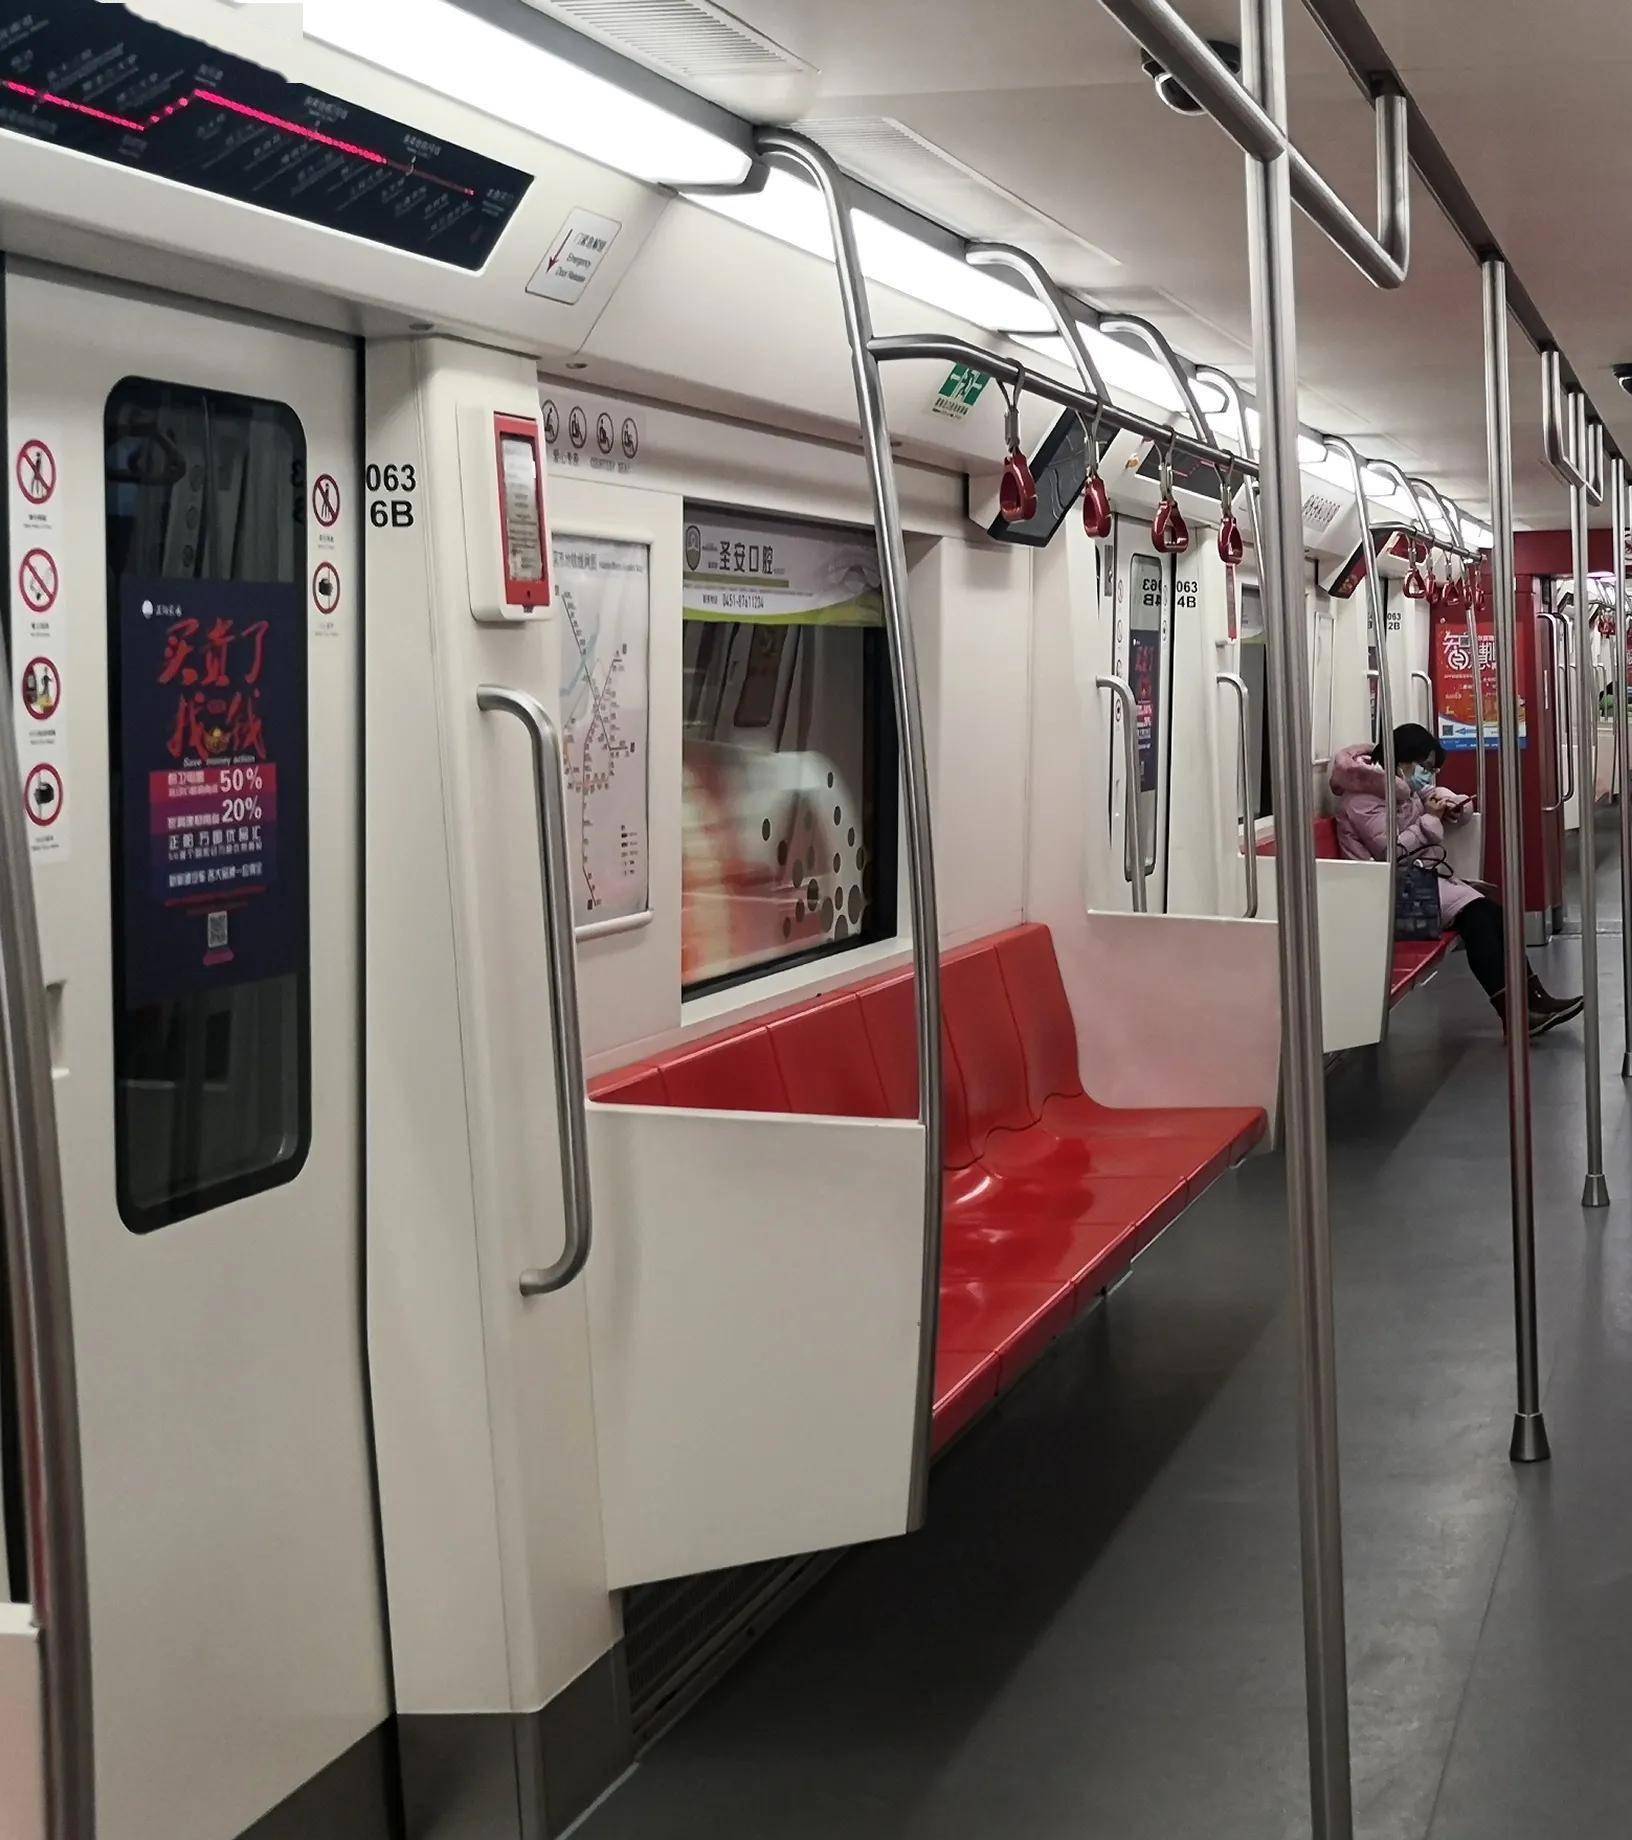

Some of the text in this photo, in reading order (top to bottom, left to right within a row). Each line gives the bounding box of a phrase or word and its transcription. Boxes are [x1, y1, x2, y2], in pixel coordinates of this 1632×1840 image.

[366, 463, 417, 492] 063
[370, 500, 415, 528] 6B
[719, 540, 774, 575] 圣安口腔
[1176, 580, 1199, 594] 063
[1176, 595, 1197, 608] 4B
[1387, 612, 1401, 621] 063
[1388, 621, 1401, 631] 2B
[220, 766, 263, 793] 50%
[222, 795, 262, 824] 20%
